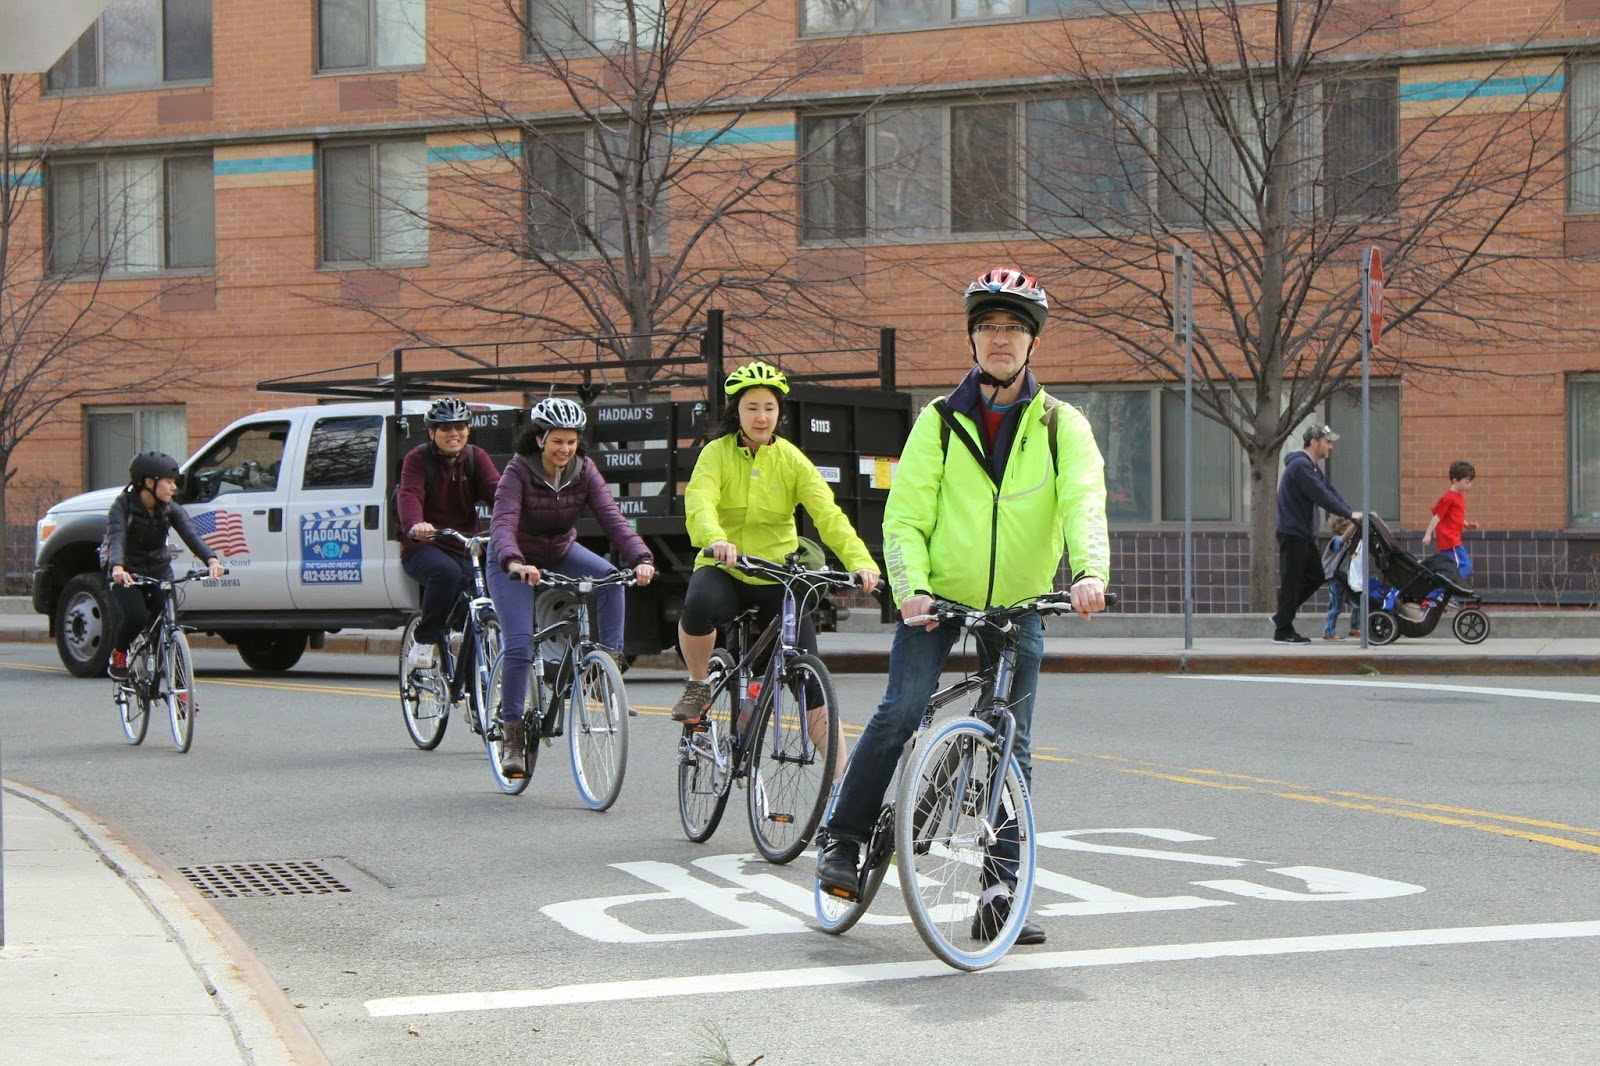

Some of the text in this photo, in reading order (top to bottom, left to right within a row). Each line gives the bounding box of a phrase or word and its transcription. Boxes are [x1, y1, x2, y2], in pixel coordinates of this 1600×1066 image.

[1370, 279, 1383, 314] STOP
[598, 407, 653, 422] HADDAD'S
[811, 419, 830, 433] 51113
[605, 453, 642, 467] TRUCK
[474, 505, 492, 518] TAL
[616, 500, 647, 514] NTAL
[304, 529, 358, 546] HADDAD'S
[303, 570, 360, 581] 412-655-8822
